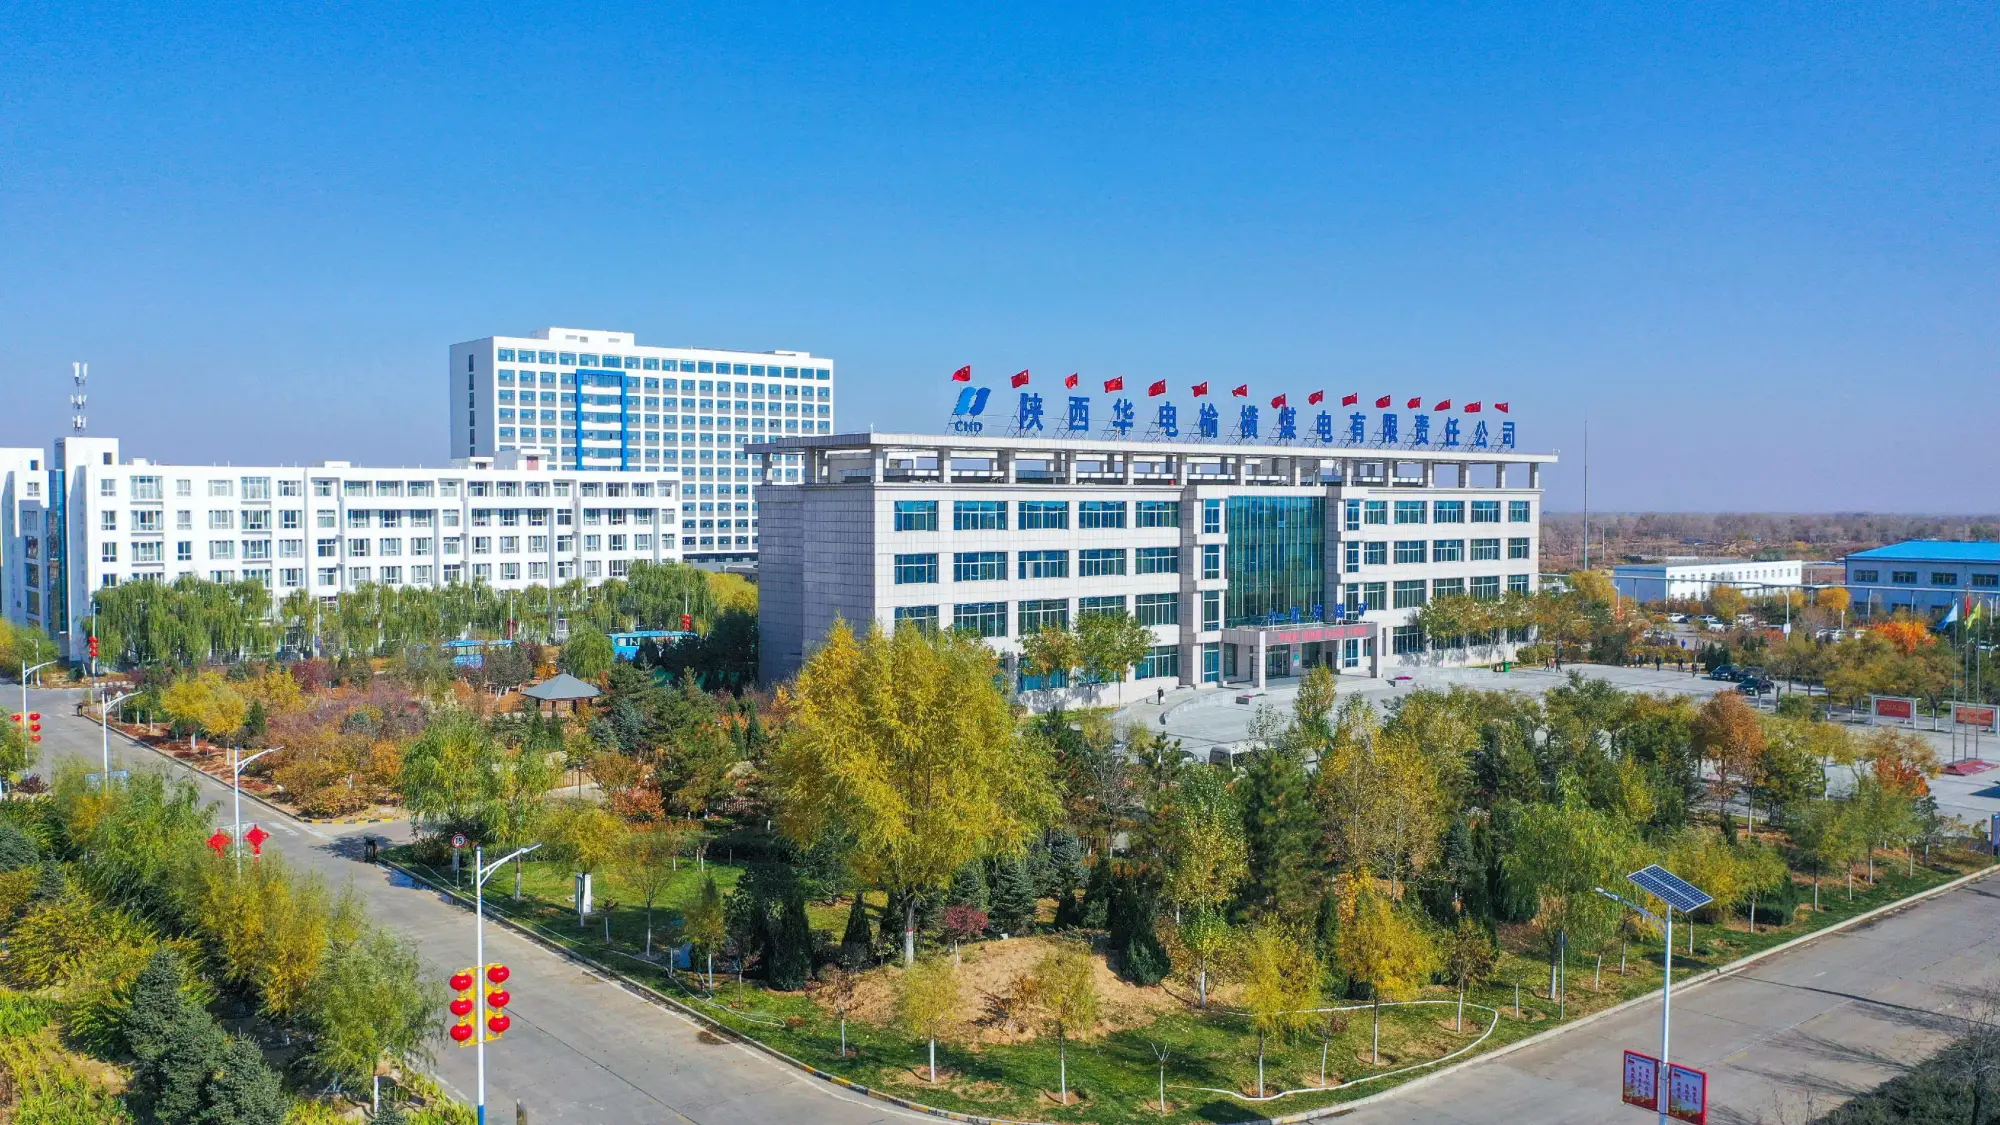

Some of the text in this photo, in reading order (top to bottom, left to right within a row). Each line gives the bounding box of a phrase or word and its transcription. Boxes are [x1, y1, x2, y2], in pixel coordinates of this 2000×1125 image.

[954, 420, 983, 433] CHD
[1020, 392, 1515, 449] 陕西华电榆横煤电有限责任公司
